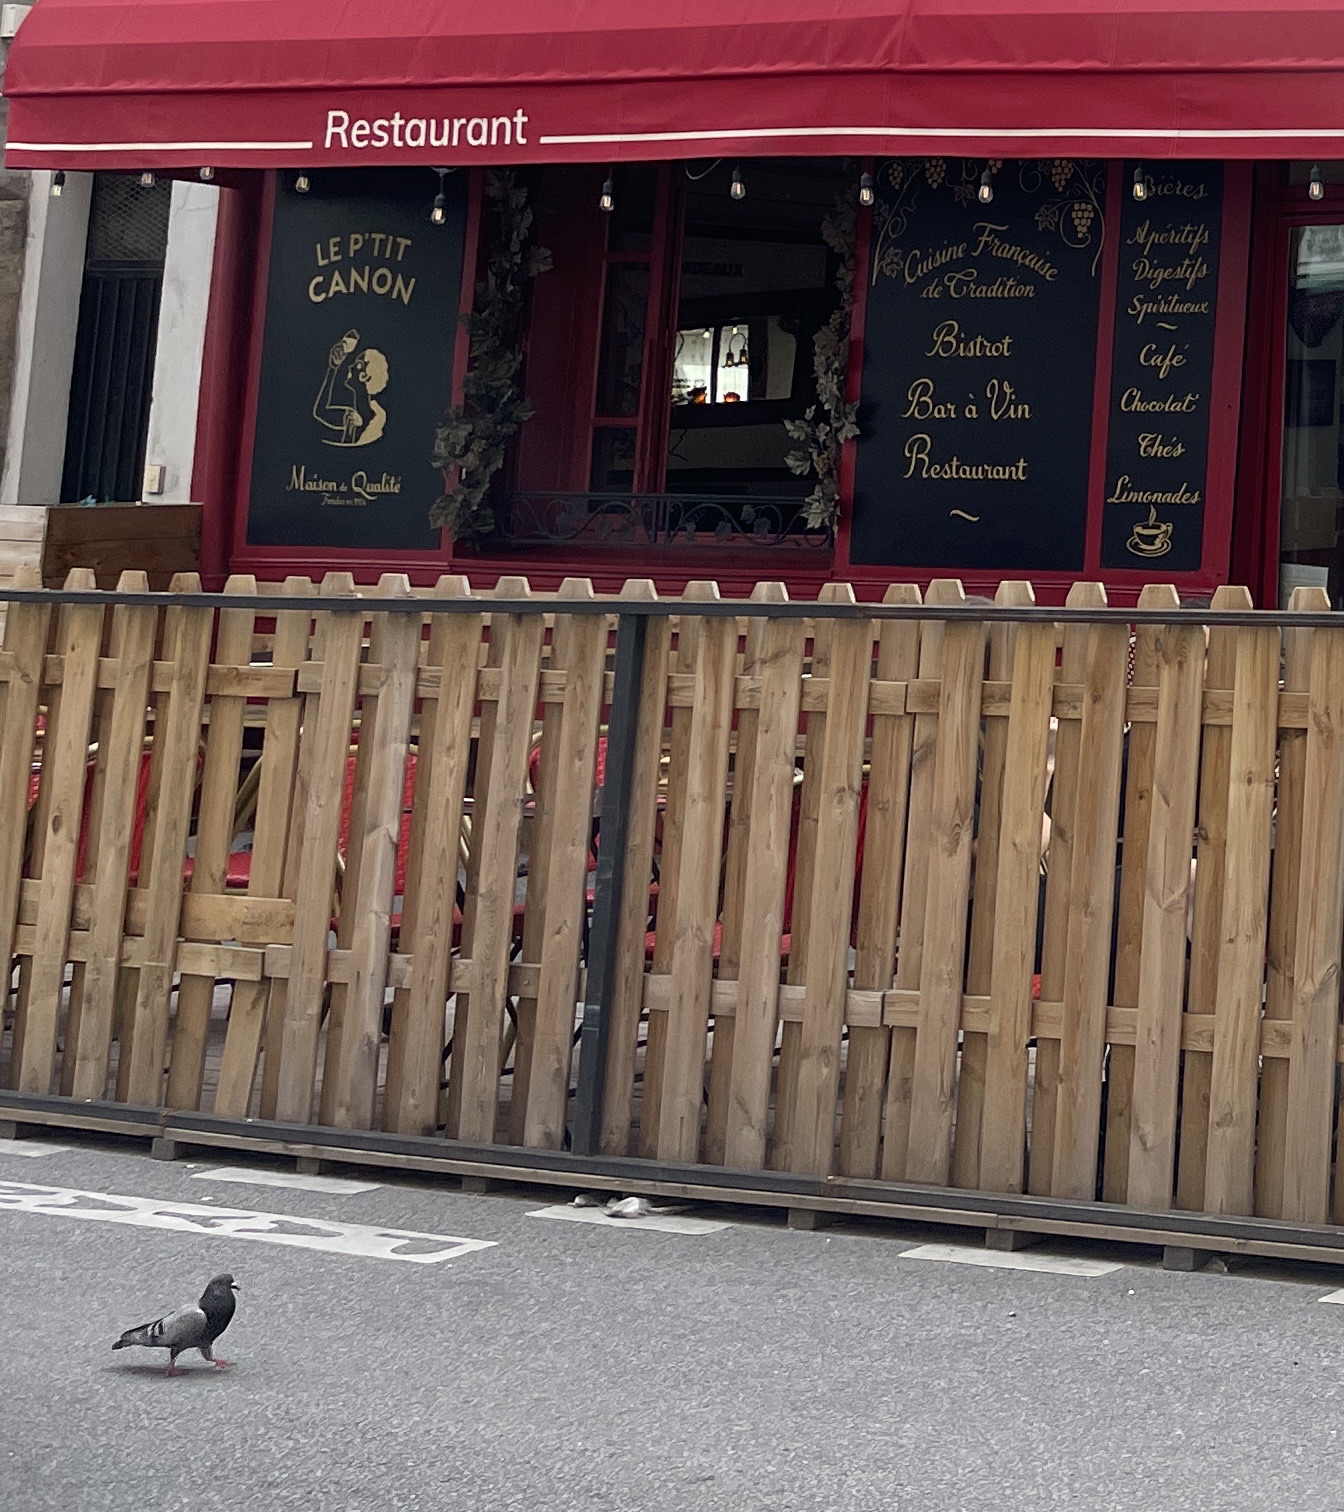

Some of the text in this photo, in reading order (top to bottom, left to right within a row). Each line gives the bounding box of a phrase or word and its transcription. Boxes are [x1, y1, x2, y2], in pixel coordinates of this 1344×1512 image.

[324, 108, 529, 149] Restaurant
[315, 236, 342, 266] LE
[903, 222, 1059, 287] Cuisine Française
[1126, 220, 1210, 255] Apéritifs
[308, 266, 416, 304] CANON
[921, 268, 1036, 299] de Tradition
[1132, 257, 1210, 290] Digestifs
[1127, 293, 1210, 325] Spiritueux
[925, 320, 1013, 358] Bistrot
[1139, 344, 1190, 379] Café
[900, 378, 1032, 420] Bar à Vin
[1120, 388, 1200, 413] Chocolat
[903, 433, 1028, 481] Restaurant
[1137, 433, 1185, 458] Thés
[286, 464, 337, 491] Maison
[351, 470, 402, 500] Qualité
[1107, 475, 1201, 505] Limonades
